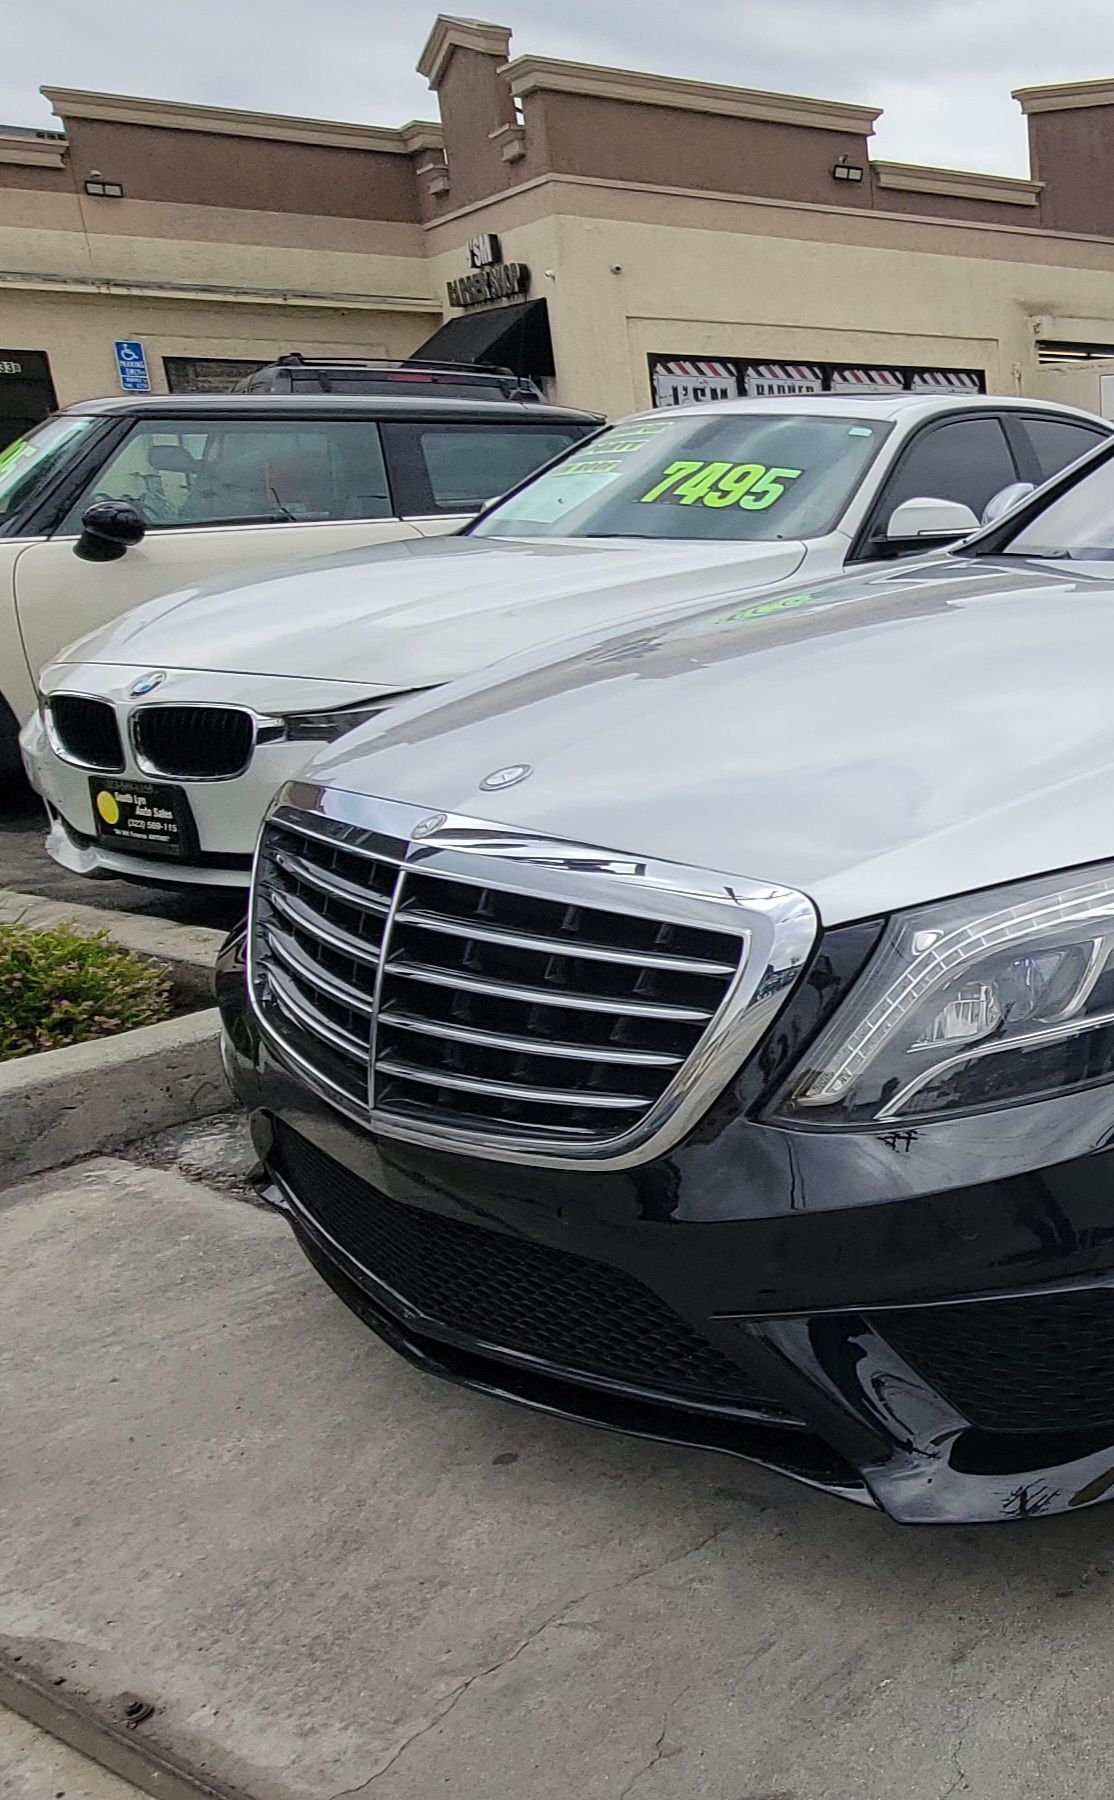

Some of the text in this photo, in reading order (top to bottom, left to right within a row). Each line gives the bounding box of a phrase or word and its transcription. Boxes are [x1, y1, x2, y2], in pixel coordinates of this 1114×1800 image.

[640, 461, 802, 510] 7495
[135, 805, 173, 820] Auto Sales
